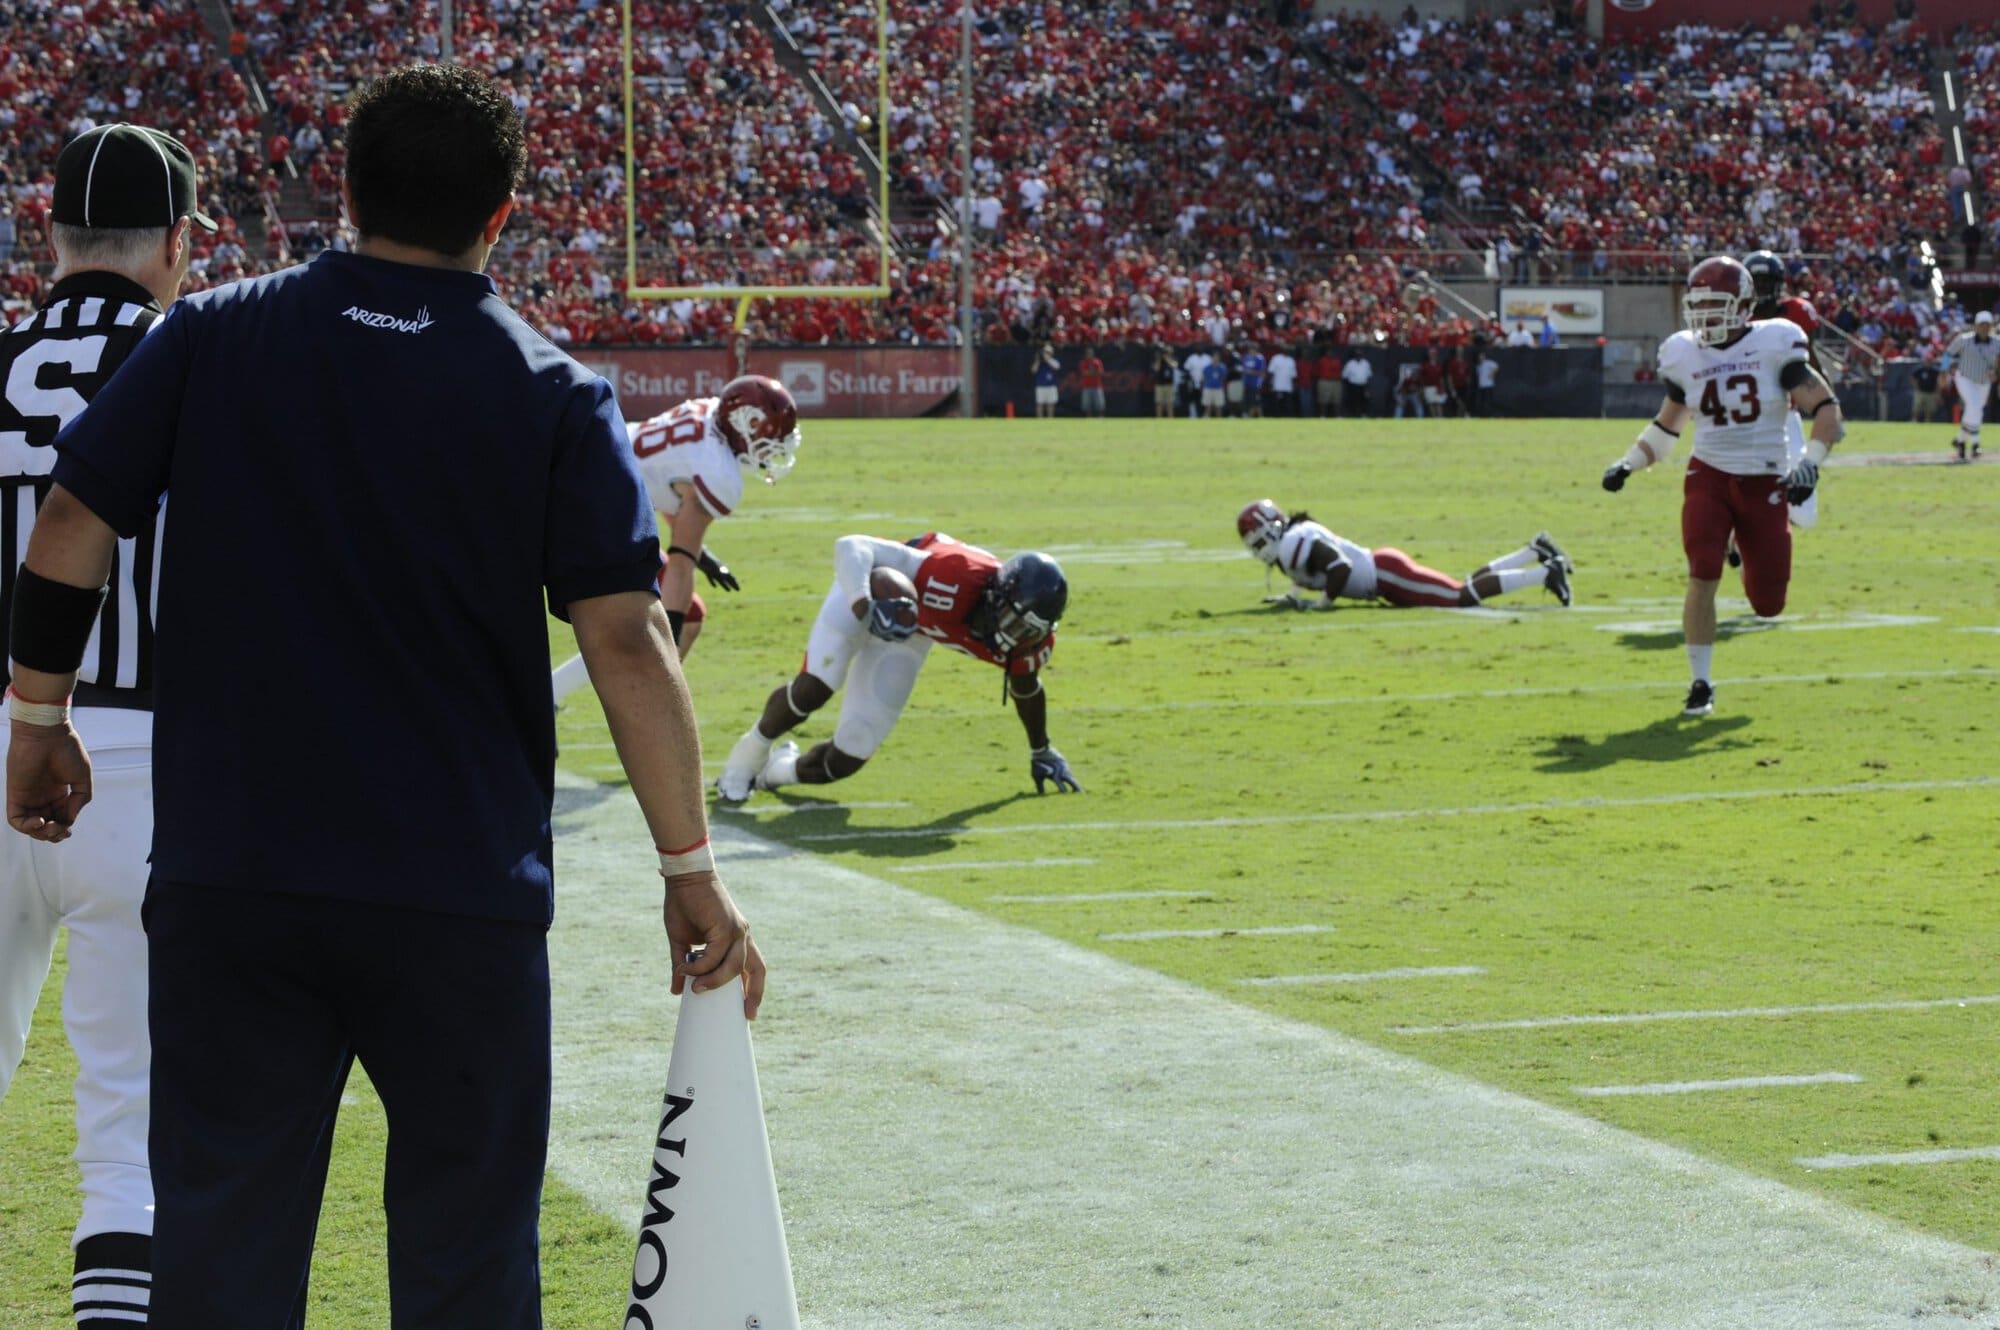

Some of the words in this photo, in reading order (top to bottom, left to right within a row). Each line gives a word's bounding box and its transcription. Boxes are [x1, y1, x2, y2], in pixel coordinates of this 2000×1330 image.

[342, 306, 418, 334] ARIZONA
[622, 370, 688, 396] State
[694, 369, 725, 396] Fa
[829, 369, 893, 395] State
[1700, 375, 1761, 425] 43
[923, 575, 960, 610] 18
